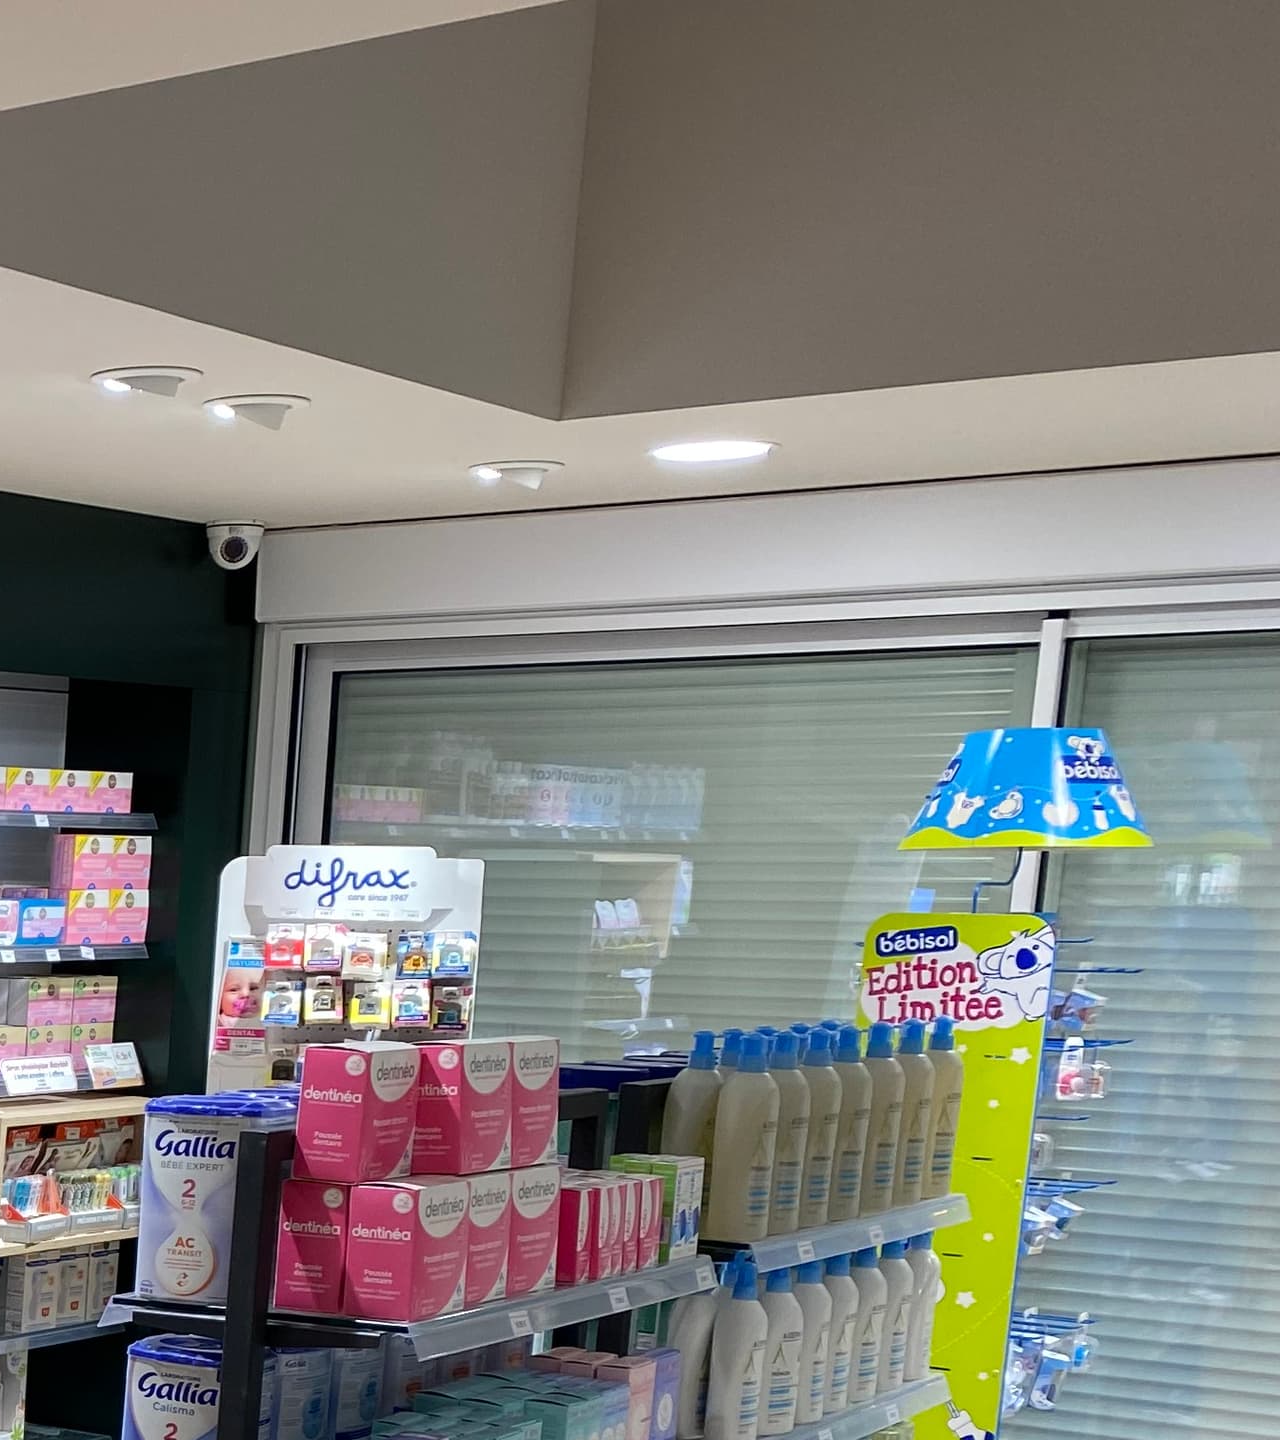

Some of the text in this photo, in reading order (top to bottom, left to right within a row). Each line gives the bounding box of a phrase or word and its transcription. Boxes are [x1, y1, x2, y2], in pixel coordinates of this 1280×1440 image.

[284, 858, 410, 907] difrax
[880, 930, 954, 953] bébisol
[866, 957, 978, 996] Edition
[304, 1086, 362, 1103] dentinéa
[155, 1129, 237, 1159] Gallia
[187, 1163, 224, 1172] EXPERT
[182, 1179, 196, 1198] 2
[283, 1218, 340, 1236] dentinéa
[352, 1223, 411, 1241] dentinéa
[175, 1236, 195, 1248] AC
[138, 1372, 220, 1406] Gallia
[152, 1402, 195, 1417] Calisma
